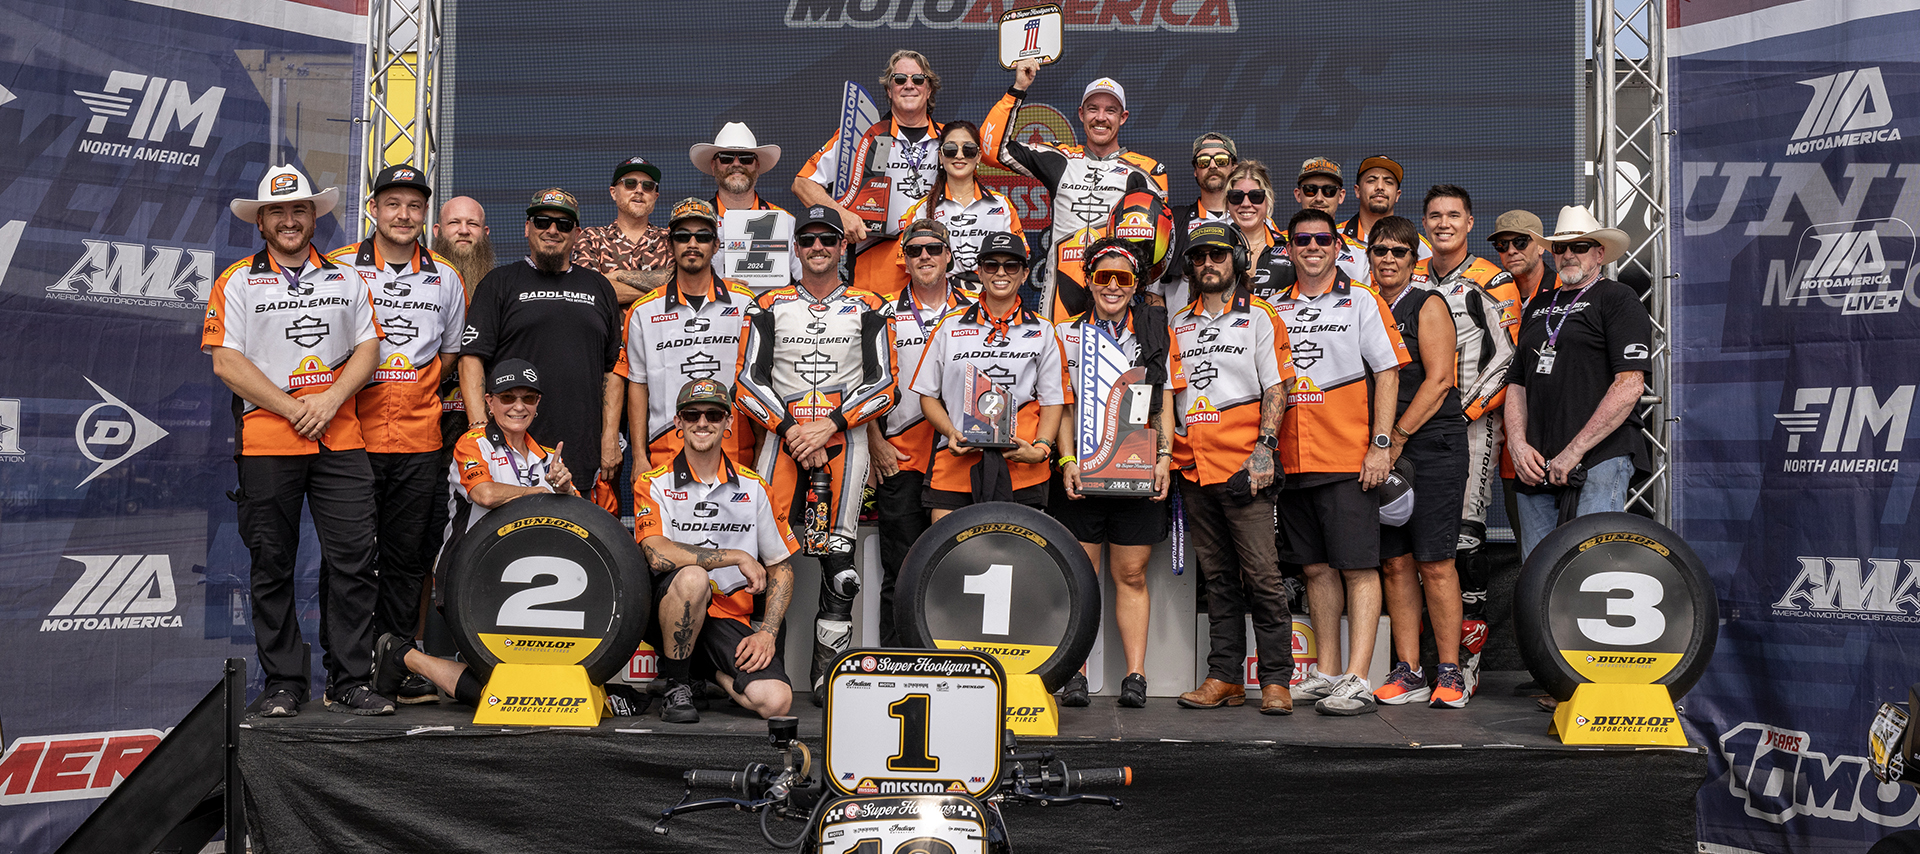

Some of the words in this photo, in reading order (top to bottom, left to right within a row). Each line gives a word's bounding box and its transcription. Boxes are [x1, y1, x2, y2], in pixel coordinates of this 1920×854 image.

[73, 70, 226, 148] FIM
[836, 82, 858, 198] MOTOAMERICA
[1786, 128, 1901, 156] MOTOAMERICA
[79, 139, 131, 158] NORTH
[133, 147, 200, 167] AMERICA
[852, 138, 870, 185] CHAMPIONSHIP
[1117, 228, 1153, 237] MISSION
[46, 239, 216, 301] AMA
[1800, 275, 1891, 290] MOTOAMERICA
[45, 292, 94, 303] AMERICAN
[93, 296, 162, 308] MOTORCYCLIST
[162, 301, 208, 311] ASSOCIATI
[519, 290, 596, 303] SADDLEMEN
[255, 297, 350, 313] SADDLEMEN
[374, 297, 442, 313] DDLEMEN
[653, 314, 678, 323] MOTUL
[953, 329, 978, 338] MOTUL
[1287, 324, 1348, 334] DDLEMEN
[656, 336, 740, 351] SADDLEMEN
[782, 336, 850, 345] SADDLEMEN
[952, 351, 1040, 361] SADDLEMEN
[1181, 345, 1245, 359] ADDLEMEN
[290, 373, 333, 387] MISSION
[375, 371, 416, 382] MISSION
[1083, 326, 1096, 455] MOTOAMERICA
[985, 395, 999, 414] 2
[1773, 385, 1916, 452] FIM
[1083, 441, 1113, 470] SUPERBIKE
[1107, 387, 1121, 442] CHAMPIONSHIP
[1783, 459, 1824, 473] NORTH
[1829, 459, 1899, 473] AMERICA
[665, 490, 687, 500] MOTUL
[514, 517, 575, 531] DUNLOP
[672, 518, 751, 533] SADDLEMEN
[1593, 532, 1656, 547] DUNLOP
[496, 555, 588, 630] 2
[963, 564, 1013, 636] 1
[1577, 571, 1667, 646] 3
[1772, 609, 1815, 619] AMERICAN
[1816, 611, 1884, 621] MOTORCYCLIST
[1885, 614, 1920, 623] ASSOCIA
[40, 616, 183, 632] MOTOAMERICA
[516, 639, 576, 649] DUNLOP
[972, 646, 1031, 656] DUNLOP
[877, 657, 914, 672] Super
[915, 657, 970, 676] Hooligan
[1597, 655, 1657, 665] DUNLOP
[845, 678, 872, 688] Indian
[503, 696, 588, 707] DUNLOP
[500, 705, 552, 714] MOTORCYCLE
[556, 706, 580, 714] TIRES
[1007, 706, 1046, 717] LOP
[1014, 716, 1038, 724] TIRES
[1592, 716, 1675, 727] DUNLOP
[886, 693, 940, 772] 1
[1590, 725, 1642, 734] MOTORCYCLE
[1646, 726, 1669, 734] TIRES
[1765, 731, 1801, 752] YEARS
[881, 781, 944, 793] MISSION
[862, 802, 898, 818] Super
